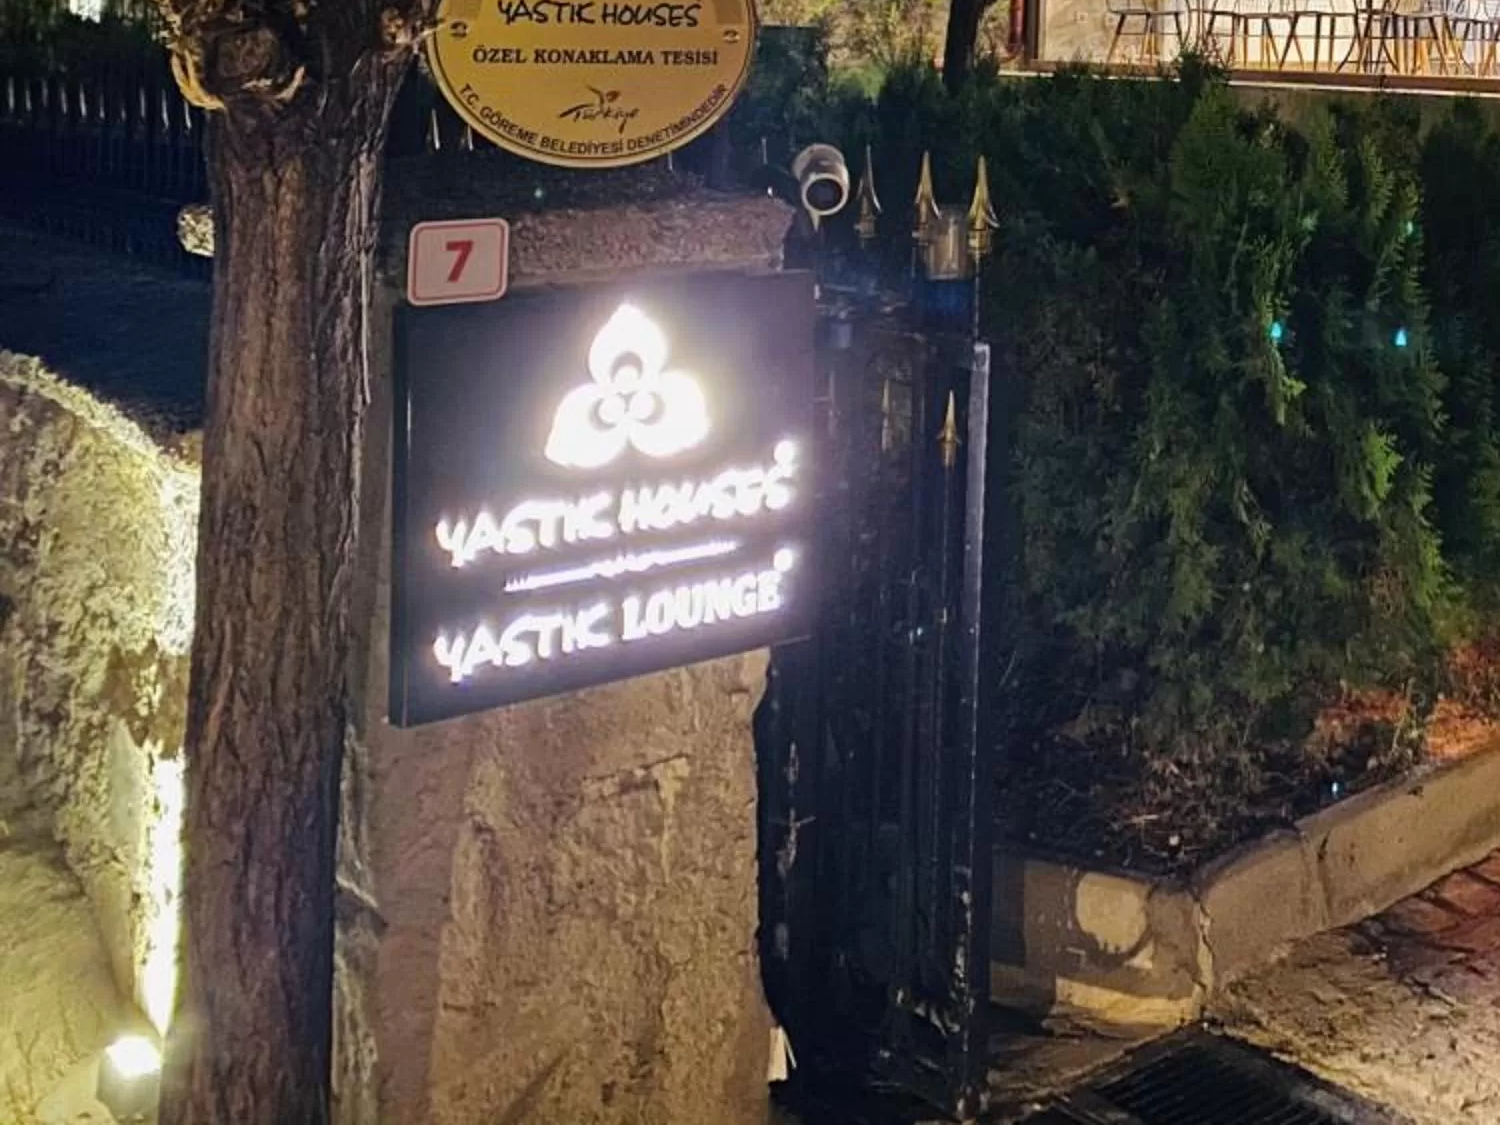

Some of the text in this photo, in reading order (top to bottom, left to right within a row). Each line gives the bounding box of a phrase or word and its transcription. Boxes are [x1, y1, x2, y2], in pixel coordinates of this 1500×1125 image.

[602, 1, 701, 26] HOUSES
[472, 45, 527, 64] ÖZEL
[533, 48, 654, 65] KONAKLAMA
[479, 105, 538, 145] GÖREME
[540, 136, 625, 155] BELEDİYESİ
[444, 240, 474, 283] 7
[621, 571, 783, 640] LOUNGE
